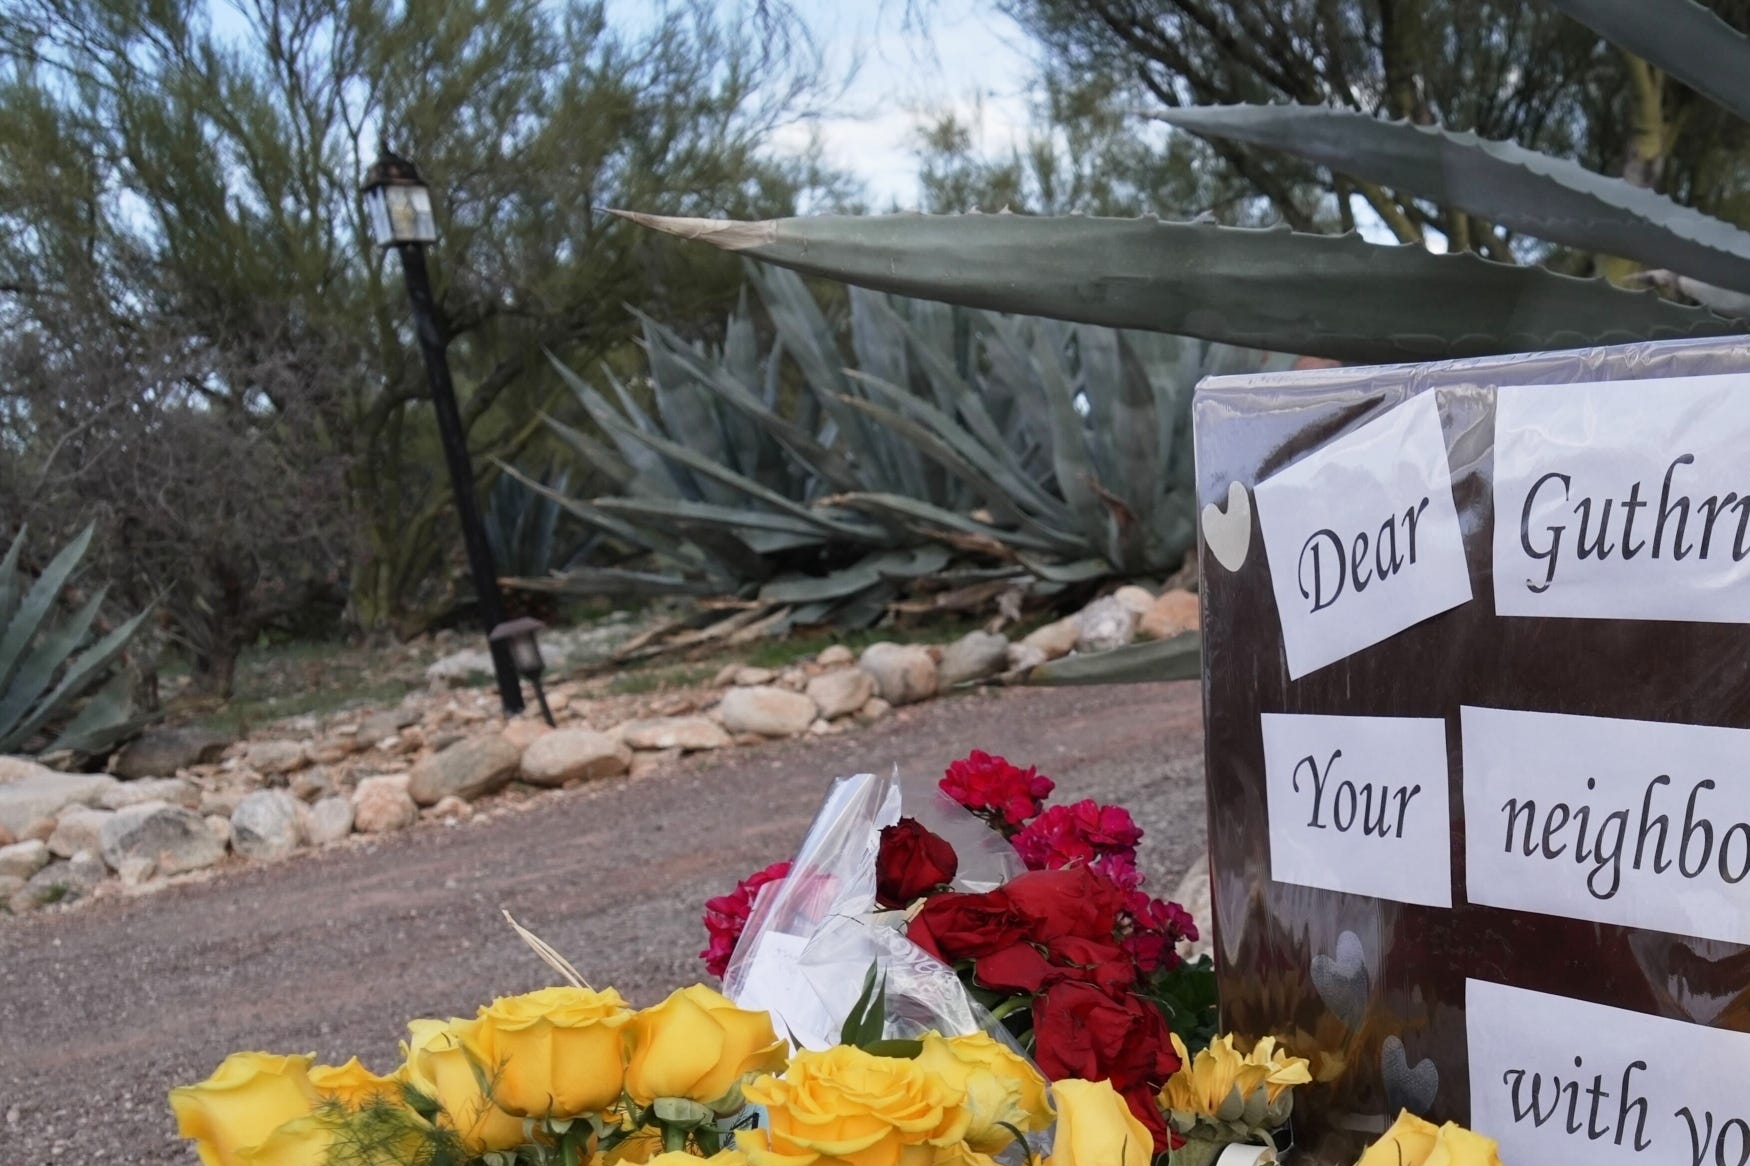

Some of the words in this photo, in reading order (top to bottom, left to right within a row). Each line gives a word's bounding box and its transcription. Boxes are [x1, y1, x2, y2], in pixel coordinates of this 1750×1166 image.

[1298, 496, 1430, 614] Dear
[1293, 750, 1422, 838] Your
[1503, 1056, 1652, 1151] with
